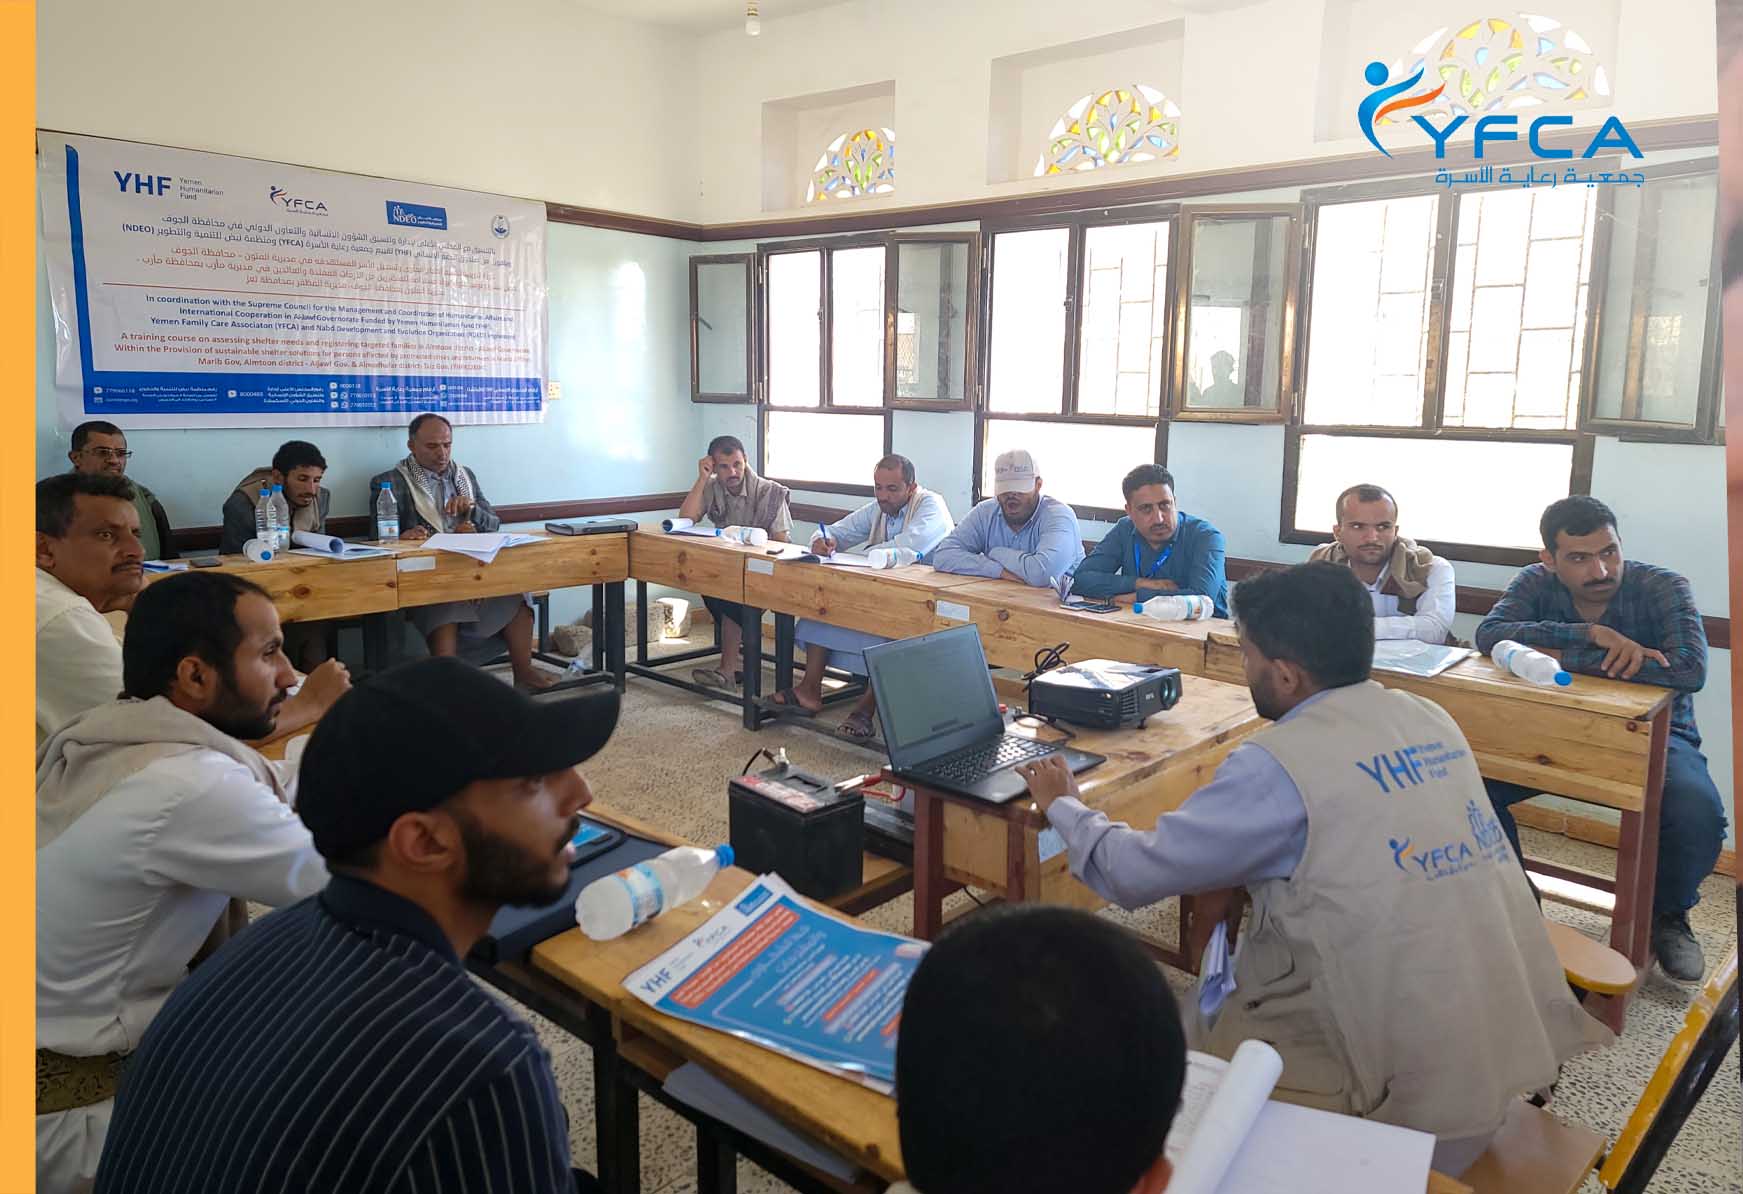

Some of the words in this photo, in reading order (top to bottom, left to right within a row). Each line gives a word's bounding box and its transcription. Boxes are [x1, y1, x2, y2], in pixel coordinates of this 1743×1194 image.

[114, 170, 172, 196] YHF
[180, 177, 202, 185] Yemen
[180, 186, 224, 196] Humanitarian
[281, 197, 328, 211] YFCA
[162, 216, 189, 225] الجوف
[192, 218, 225, 228] محافظة
[122, 224, 154, 234] (NDEO)
[228, 223, 242, 231] في
[245, 224, 272, 234] الدولي
[156, 227, 192, 239] والتطوير
[194, 230, 222, 240] للتنمية
[224, 233, 242, 242] نبض
[244, 234, 276, 246] ومنظمة
[278, 238, 304, 248] (YFCA)
[170, 247, 199, 256] الجوف
[201, 248, 236, 258] محافظة
[146, 294, 155, 302] In
[156, 295, 211, 306] coordination
[212, 297, 230, 307] with
[233, 299, 246, 308] the
[248, 300, 282, 310] Supreme
[284, 302, 312, 311] Council
[312, 304, 324, 312] for
[325, 304, 336, 312] the
[338, 306, 383, 315] Management
[384, 308, 396, 316] and
[398, 309, 437, 318] Coordination
[438, 310, 445, 318] of
[180, 307, 233, 318] International
[234, 310, 282, 320] Cooperation
[284, 312, 292, 320] in
[316, 314, 360, 323] Governorate
[361, 316, 386, 325] Funded
[388, 318, 396, 326] by
[397, 318, 418, 326] Yemen
[461, 321, 474, 329] Fund
[150, 316, 180, 326] Yemen
[182, 318, 208, 328] Family
[210, 319, 228, 328] Care
[274, 322, 300, 332] (YFCA)
[301, 324, 315, 332] and
[316, 324, 335, 332] Nabd
[336, 326, 382, 335] Development
[397, 328, 426, 336] Evolution
[120, 332, 128, 340] A
[130, 332, 166, 343] training
[168, 334, 196, 343] course
[212, 336, 250, 346] assessing
[251, 337, 279, 346] shelter
[281, 338, 304, 346] needs
[306, 339, 319, 347] and
[321, 340, 360, 349] registering
[114, 344, 144, 352] Within
[147, 345, 161, 353] the
[164, 345, 202, 354] Provision
[204, 346, 214, 354] of
[214, 347, 260, 356] sustainable
[260, 348, 288, 356] shelter
[288, 350, 320, 358] solutions
[322, 350, 332, 358] for
[334, 351, 360, 360] persons
[390, 352, 398, 360] by
[198, 358, 223, 366] Marib
[224, 358, 242, 368] Gov,
[244, 358, 277, 367] Almtoon
[278, 360, 304, 368] district
[334, 360, 350, 368] Gov.
[1356, 746, 1424, 793] YHF
[1412, 842, 1473, 872] YFCA
[640, 967, 673, 994] YHF
